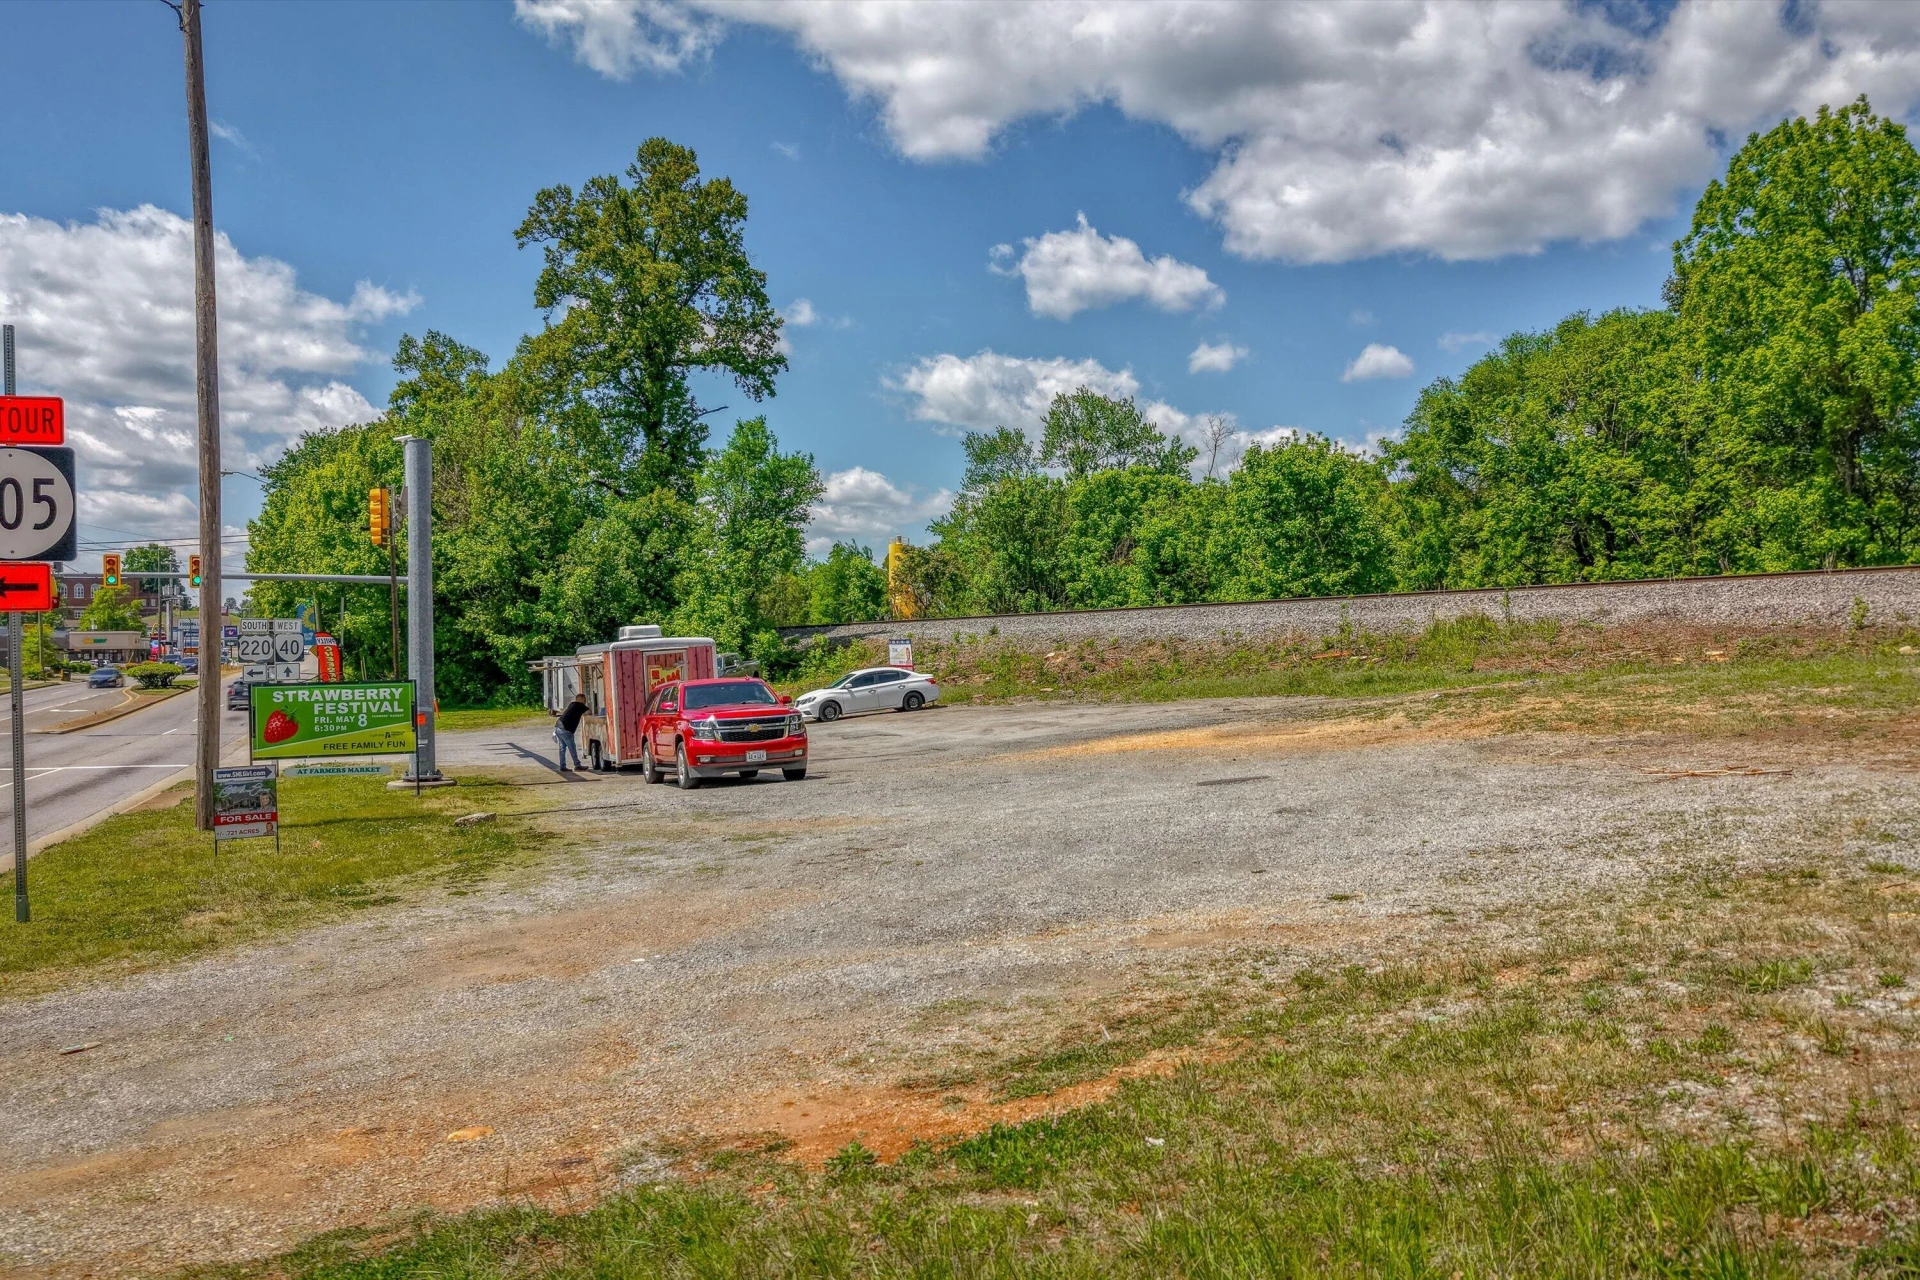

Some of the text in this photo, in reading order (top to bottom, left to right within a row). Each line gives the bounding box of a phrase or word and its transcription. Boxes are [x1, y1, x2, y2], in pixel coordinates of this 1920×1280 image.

[0, 477, 57, 531] 05
[242, 621, 267, 630] SOUTH
[277, 621, 298, 630] WEST
[240, 640, 271, 655] 220
[280, 640, 299, 655] 40
[272, 688, 403, 703] STRAWBERRY
[313, 701, 404, 715] FESTIVAL
[314, 713, 368, 727] FRI. MAY 8
[323, 740, 406, 750] FREE FAMILY FUN
[220, 813, 272, 823] FOR SALE
